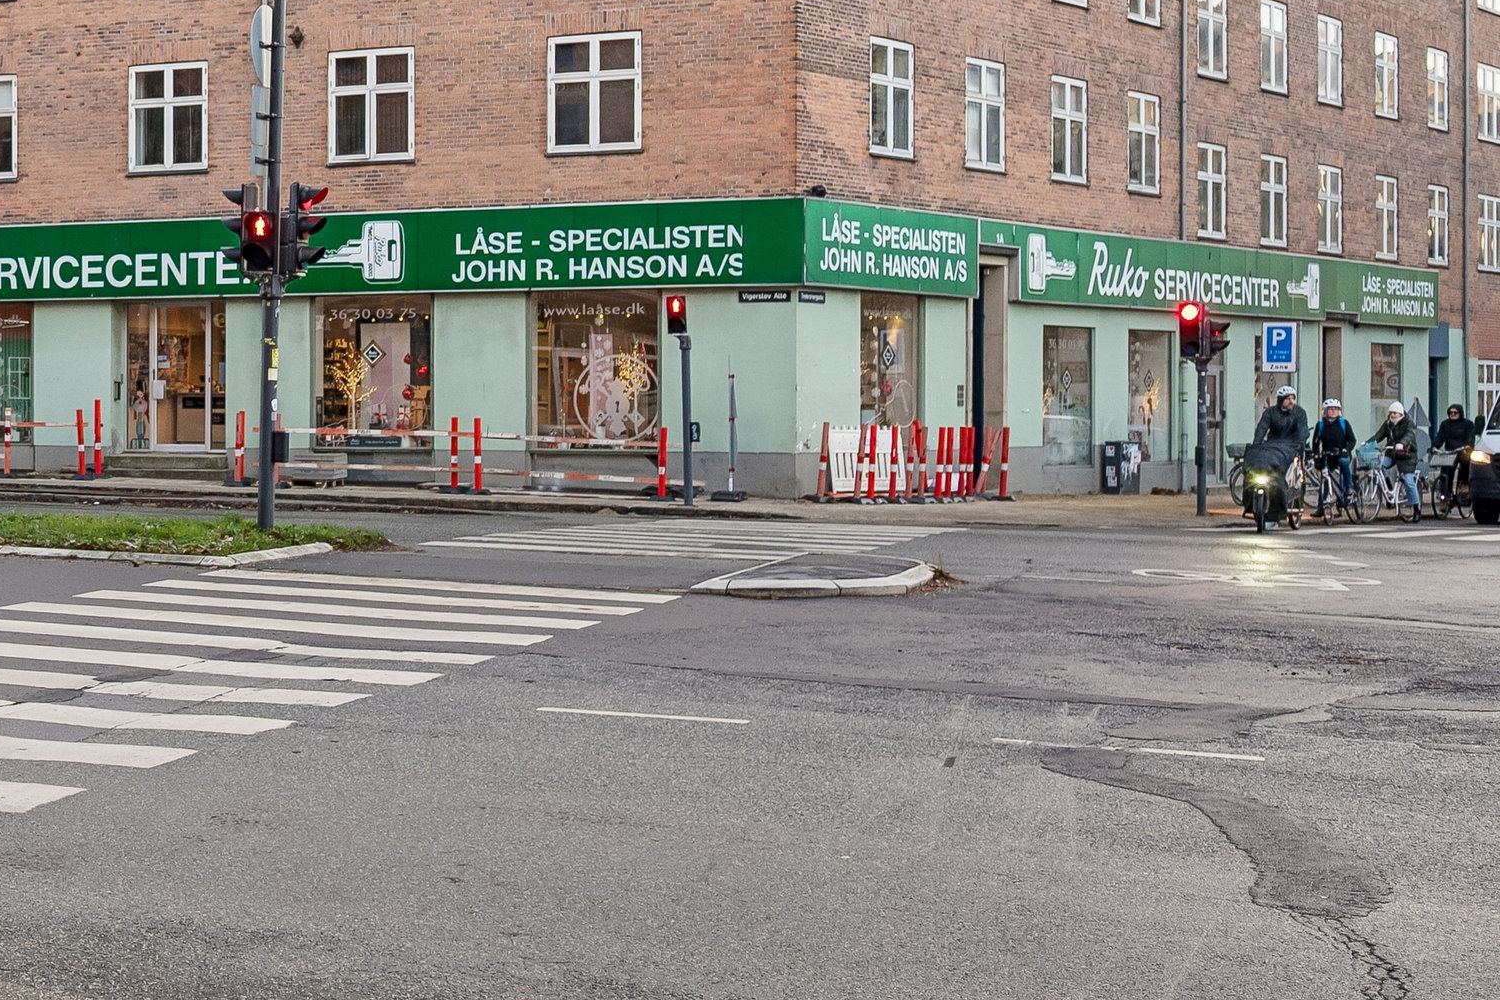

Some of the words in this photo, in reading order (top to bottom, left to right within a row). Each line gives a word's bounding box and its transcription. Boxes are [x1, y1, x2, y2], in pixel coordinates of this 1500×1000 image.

[455, 226, 523, 255] LÅSE
[549, 224, 743, 252] SPECIALISTEN
[822, 213, 860, 245] LÅSE
[872, 223, 966, 255] SPECIALISTEN
[451, 258, 526, 283] JOHN
[536, 258, 560, 281] R.
[569, 254, 687, 280] HANSON
[695, 253, 743, 277] A/S
[820, 247, 862, 274] JOHN
[865, 251, 880, 275] R.
[882, 253, 939, 280] HANSON
[944, 259, 967, 283] A/S
[1087, 241, 1150, 298] Ruko
[1154, 267, 1280, 308] SERVICECENTER
[742, 292, 772, 301] Vigerslev
[1362, 271, 1381, 294] LÅSE
[1386, 278, 1434, 298] SPECIALISTEN
[330, 308, 348, 320] 36
[353, 308, 371, 319] 30
[376, 308, 393, 319] 03
[400, 308, 417, 319] 75
[1361, 296, 1382, 313] JOHN
[1383, 298, 1390, 314] R.
[1391, 299, 1420, 317] HANSON
[1422, 301, 1435, 318] A/S
[1272, 329, 1287, 347] P
